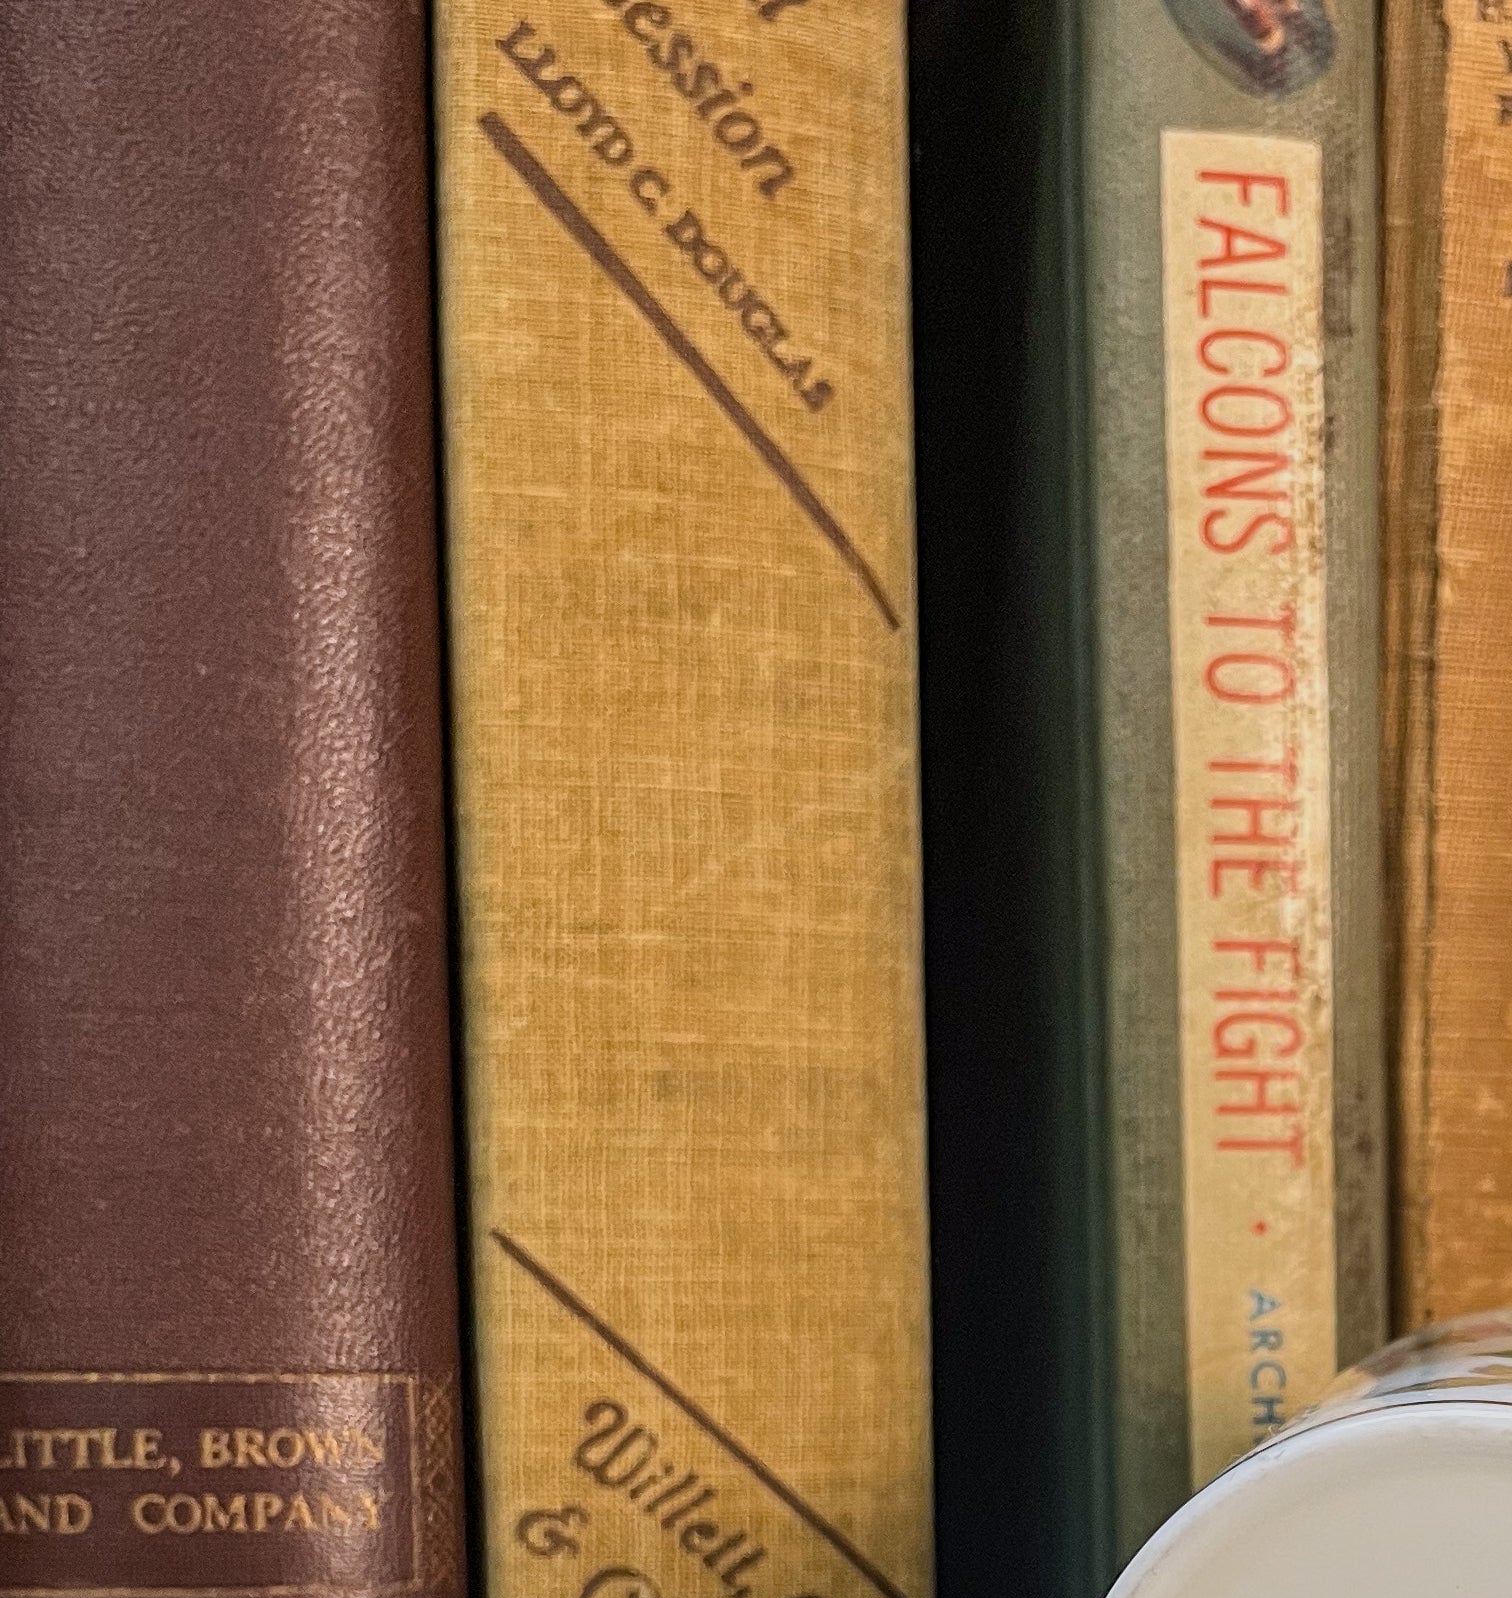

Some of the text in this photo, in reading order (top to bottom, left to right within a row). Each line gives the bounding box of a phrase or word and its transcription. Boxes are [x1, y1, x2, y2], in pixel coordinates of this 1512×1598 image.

[603, 0, 794, 198] ession
[496, 20, 634, 167] LLOYD
[664, 209, 836, 412] DOUGLAS
[1195, 169, 1306, 1167] FALCONS TO THE FIGHT
[1248, 1288, 1287, 1444] ARCH
[132, 1491, 392, 1536] COMPANY
[200, 1426, 387, 1469] BROWN
[515, 1503, 589, 1557] &
